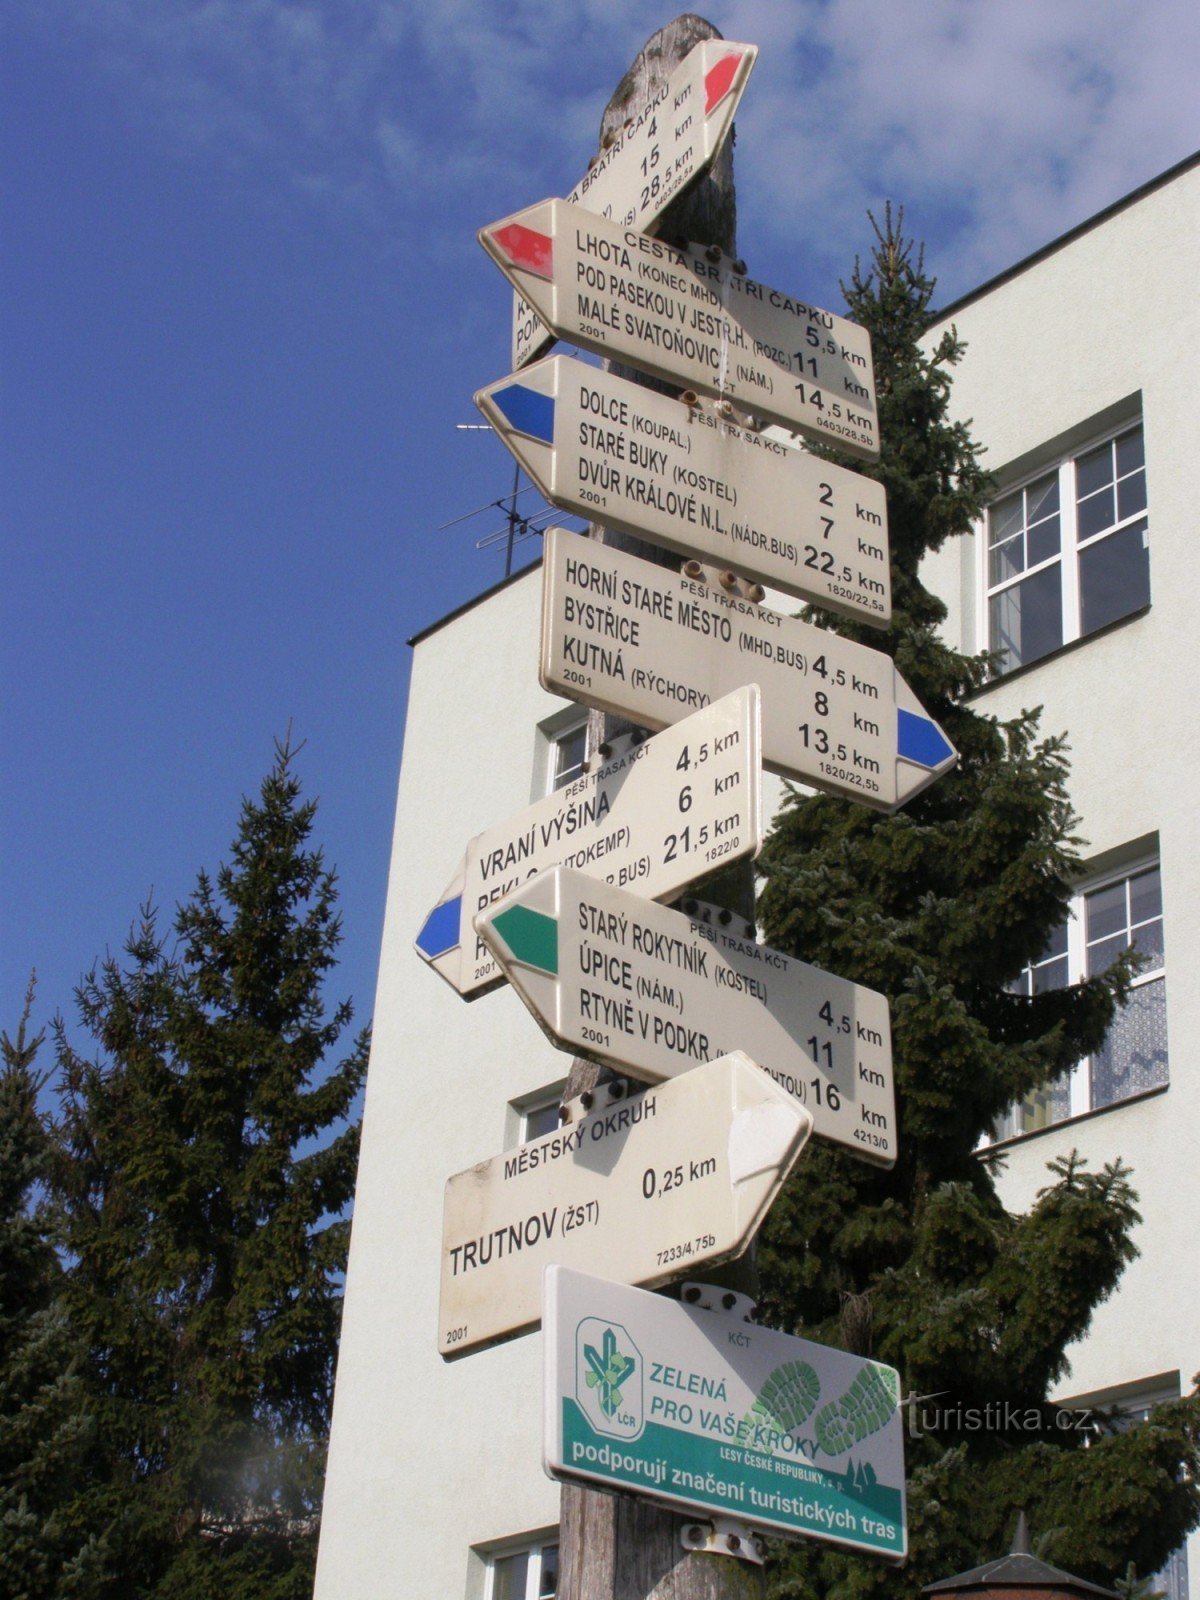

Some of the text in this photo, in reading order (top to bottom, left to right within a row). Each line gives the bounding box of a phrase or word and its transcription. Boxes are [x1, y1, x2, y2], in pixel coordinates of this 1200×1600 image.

[648, 85, 691, 138] 4 km
[641, 115, 692, 177] 15 km
[641, 146, 693, 211] 28,5 km
[577, 230, 866, 367] LHOTA (KONEC MHD) 5,5 km
[625, 232, 833, 330] CESTA BRTŘÍ ČAPKŮ
[578, 262, 605, 291] POD
[610, 275, 673, 319] PASEKOU
[678, 303, 686, 324] V
[794, 352, 817, 378] 11
[844, 377, 869, 399] km
[580, 323, 605, 340] 2001
[578, 294, 872, 430] MALÉ SVATOŇOVIC (NÁM.) 14,5 km
[581, 386, 881, 526] DOLCE (KOUPAL.) 2 km
[765, 441, 788, 456] KČT
[579, 489, 607, 507] 2001
[580, 422, 883, 560] STARÉ BUKY (KOSTEL) 7 km
[579, 457, 885, 595] DVŮR KRÁLOVÉ N.L. (NÁDR.BUS) 22,5 km
[681, 581, 782, 627] PĚŠÍ TRASA KČT
[827, 582, 884, 612] 1820/22,5a
[566, 558, 878, 699] HORNÍ STARÉ MĚSTO (MHD,BUS) 4,5 km
[564, 669, 591, 687] 2001
[565, 596, 879, 736] BYSTŘICE 8 km
[564, 635, 625, 681] KUTNÁ
[799, 723, 846, 761] 13,5
[854, 749, 880, 774] km
[565, 744, 650, 800] PĚŠÍ TRASA KČT
[679, 786, 692, 813] 6
[715, 772, 740, 796] km
[819, 762, 879, 792] 1820/22,5b
[480, 730, 739, 880] VRANÍ VÝŠINA 4,5 km
[664, 826, 708, 864] 21,5
[715, 813, 740, 837] km
[705, 837, 739, 862] 1822/0
[475, 961, 495, 980] 2001
[690, 923, 788, 971] PĚŠÍ TRASA KČT
[579, 902, 882, 1047] STARÝ ROKYTNÍK (KOSTEL) 4,5 km
[580, 940, 885, 1088] ÚPICE (NÁM.) 11 km
[582, 1027, 609, 1047] 2001
[580, 988, 634, 1035] RTYNĚ
[639, 1010, 649, 1039] V
[654, 1016, 713, 1062] PODKR.
[811, 1078, 840, 1111] 16
[862, 1104, 887, 1129] km
[504, 1096, 656, 1180] MĚSTSKÝ OKRUH
[853, 1128, 888, 1150] 4213/0
[451, 1157, 716, 1276] TRUTNOV (ŽST) 0,25 km
[656, 1233, 716, 1266] 7233/4,75b
[446, 1326, 468, 1344] 2001
[728, 1331, 751, 1348] KČT
[649, 1363, 728, 1402] ZELENÁ
[618, 1412, 636, 1427] LČR
[651, 1397, 821, 1460] PRO VAŠE KROKY
[720, 1447, 741, 1462] LESY
[744, 1452, 772, 1472] ČESKÉ
[573, 1439, 896, 1540] podporují značení turistických tras
